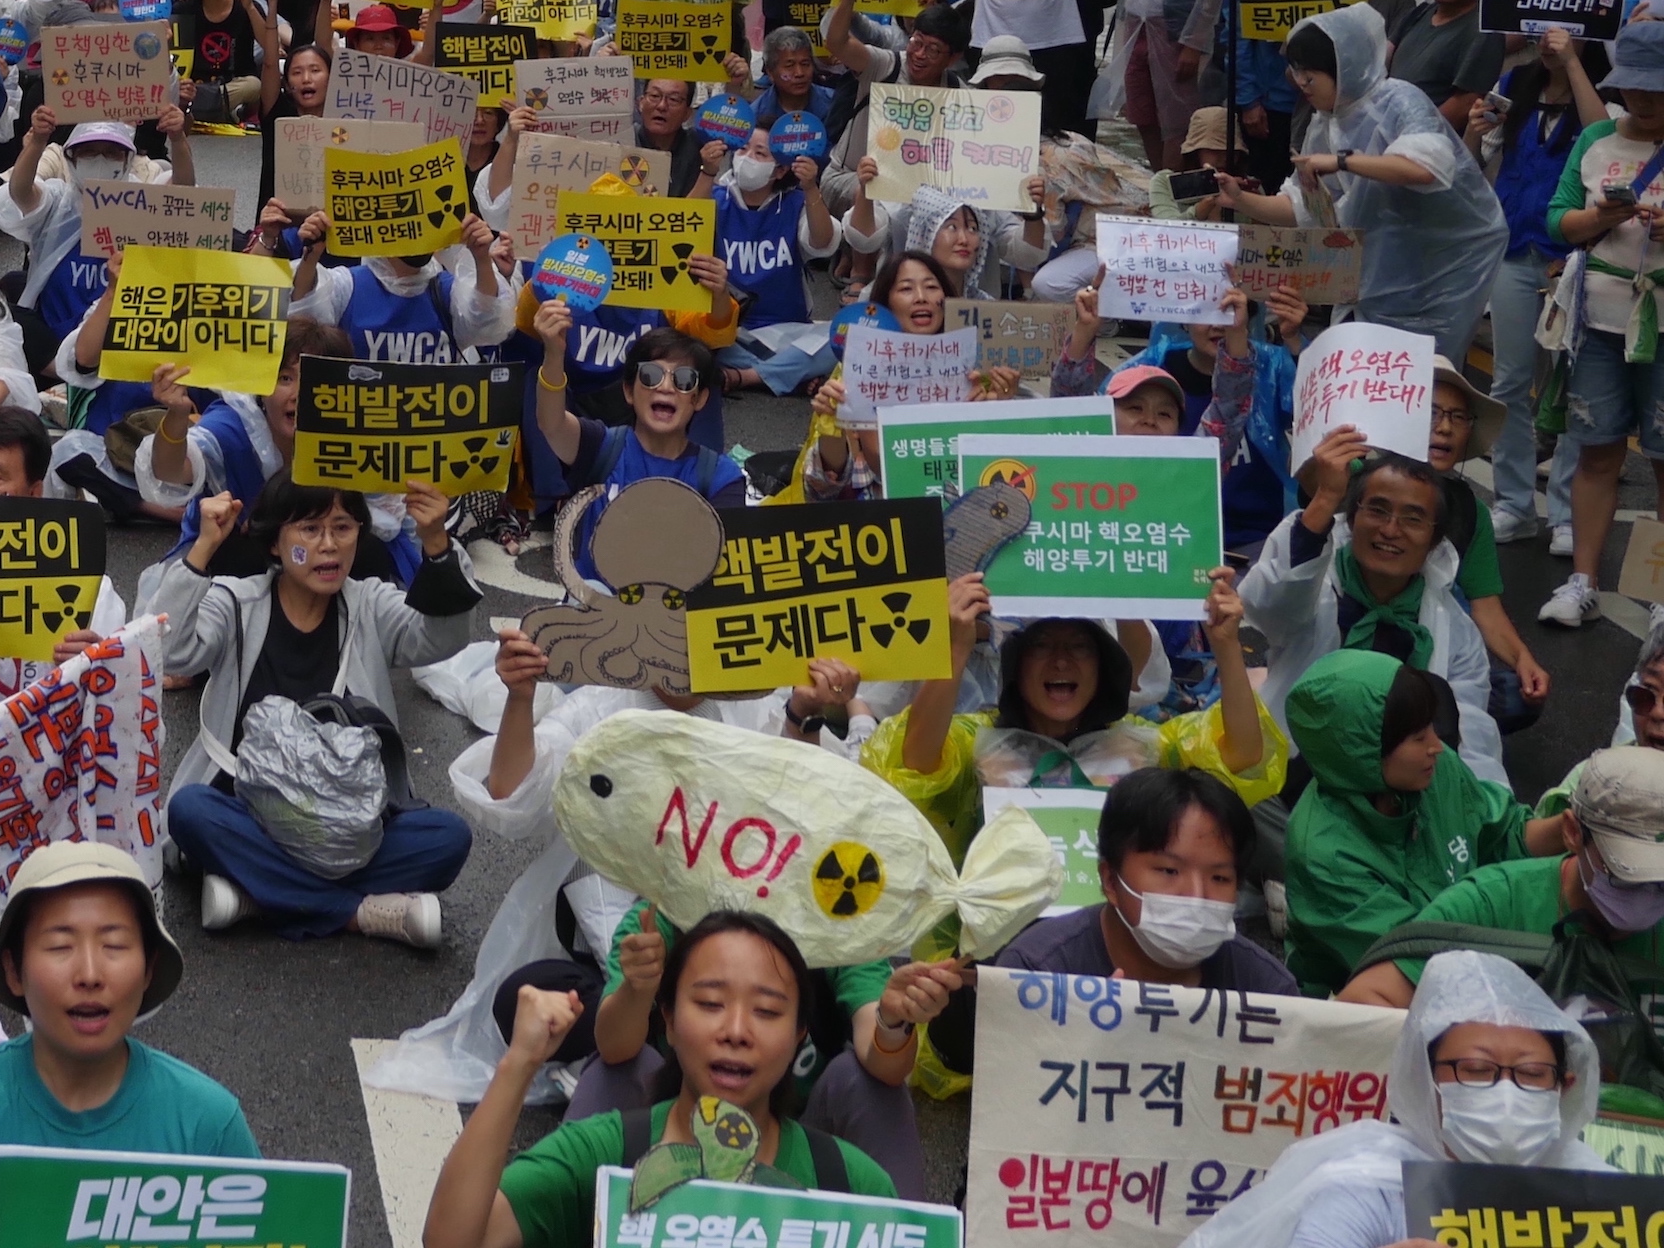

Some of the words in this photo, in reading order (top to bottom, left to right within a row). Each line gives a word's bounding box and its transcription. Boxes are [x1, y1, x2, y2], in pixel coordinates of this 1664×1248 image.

[499, 6, 545, 22] 대안이
[549, 5, 594, 21] 아니다
[621, 12, 679, 28] 후쿠시마
[683, 11, 725, 28] 오염수
[54, 33, 131, 55] 무책임한
[441, 34, 528, 63] 핵발전이
[621, 32, 691, 51] 해양투기
[74, 60, 147, 81] 후쿠시마
[544, 66, 589, 83] 후쿠시마
[655, 53, 688, 70] 안돼!
[783, 123, 809, 135] 우리는
[330, 167, 405, 190] 후쿠시마
[409, 156, 455, 182] 오염수
[335, 223, 373, 245] 절대
[378, 221, 422, 242] 안돼!
[564, 213, 644, 233] 후쿠시마
[647, 211, 704, 232] 오염수
[147, 230, 190, 247] 안전한
[196, 234, 231, 251] 세상
[1154, 234, 1217, 254] 위기시대
[564, 249, 585, 263] 일본
[723, 236, 793, 275] YWCA
[120, 285, 169, 315] 핵은
[172, 286, 279, 319] 기후위기
[111, 319, 188, 352] 대안이
[194, 319, 279, 354] 아니다
[364, 329, 452, 364] YWCA
[898, 340, 960, 358] 위기시대
[857, 381, 910, 401] 핵발전
[1362, 378, 1425, 412] 반대!
[313, 382, 490, 428] 핵발전이
[313, 440, 446, 484] 문제다
[1050, 481, 1138, 510] STOP
[1022, 550, 1116, 573] 해양투기
[1122, 548, 1169, 574] 반대
[711, 596, 865, 671] 문제다
[656, 784, 802, 899] NO!
[1038, 1060, 1186, 1127] 지구적
[1213, 1065, 1389, 1139] 범죄행위
[997, 1155, 1170, 1233] 일본땅에
[69, 1174, 267, 1242] 대안은
